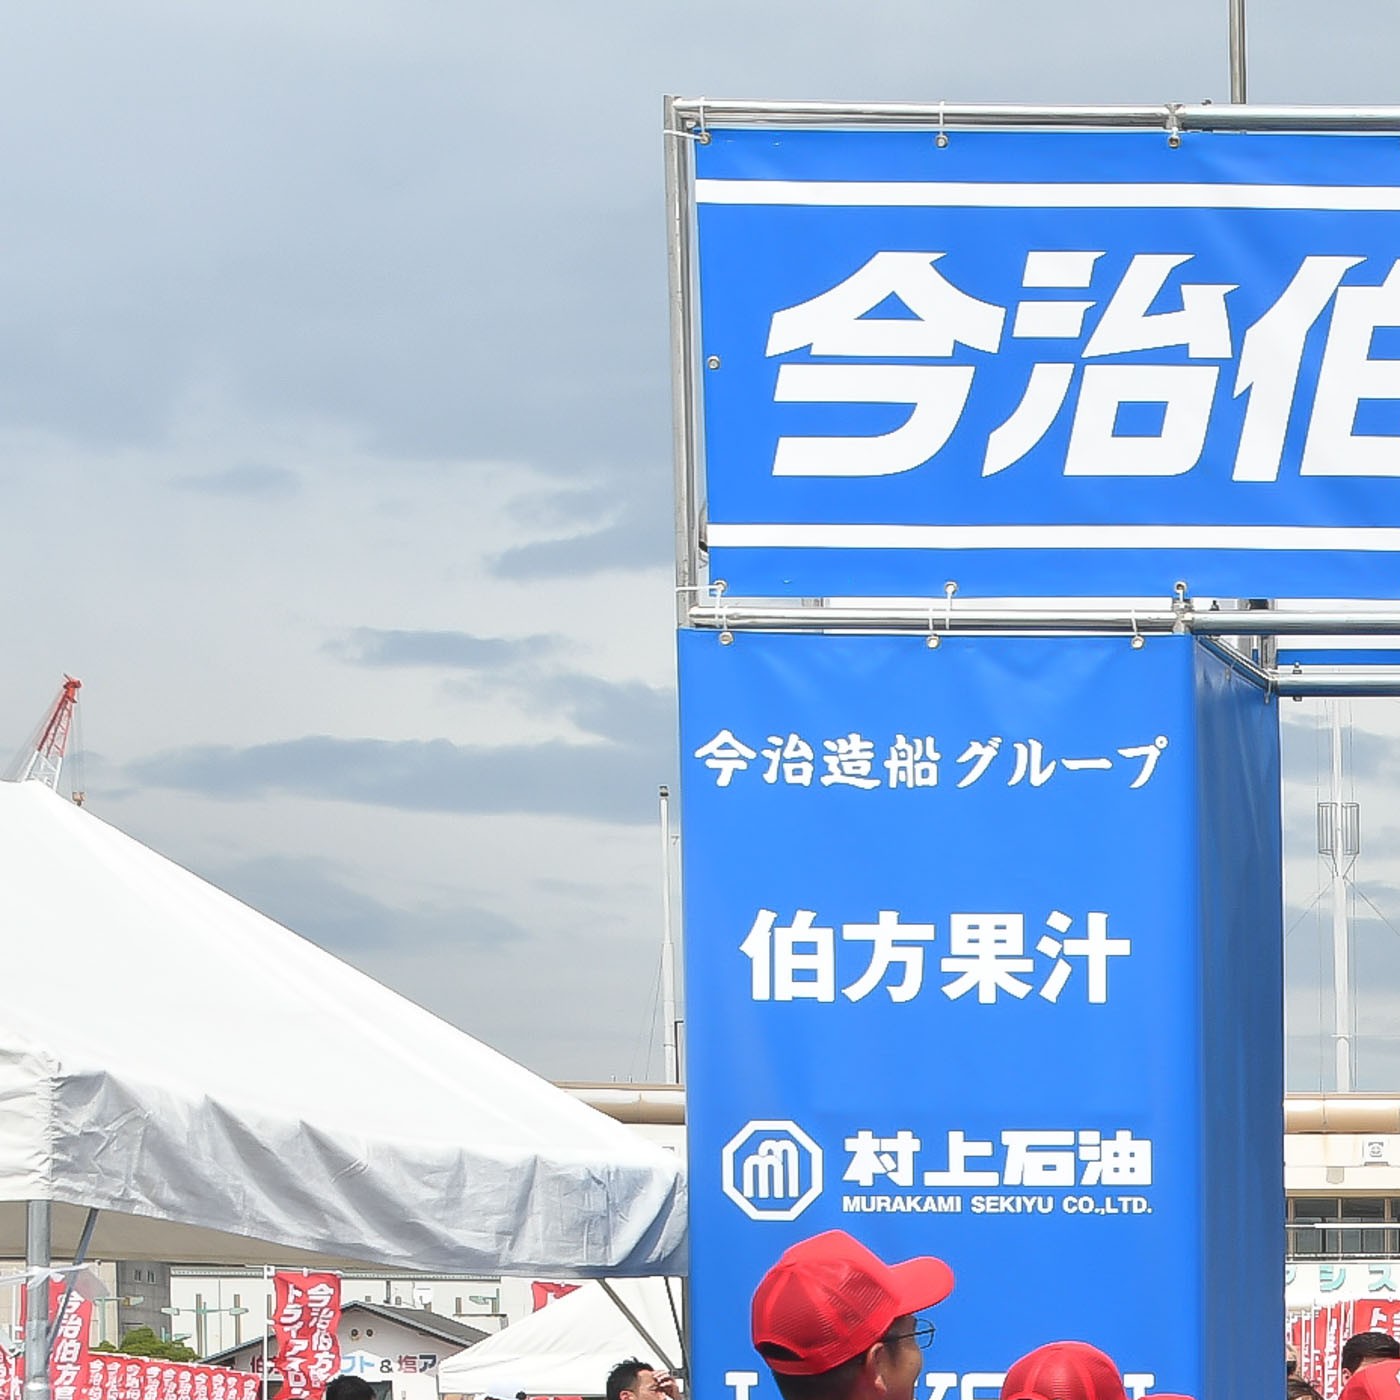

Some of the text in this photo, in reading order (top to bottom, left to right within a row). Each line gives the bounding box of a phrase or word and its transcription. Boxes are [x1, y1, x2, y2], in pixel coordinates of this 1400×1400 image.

[694, 729, 1168, 790] 今治造船グループ
[739, 909, 1131, 1004] 伯方果汁
[843, 1130, 1152, 1187] 村上石油
[843, 1196, 962, 1214] MURAKAMI
[971, 1196, 1053, 1214] SEKIYU
